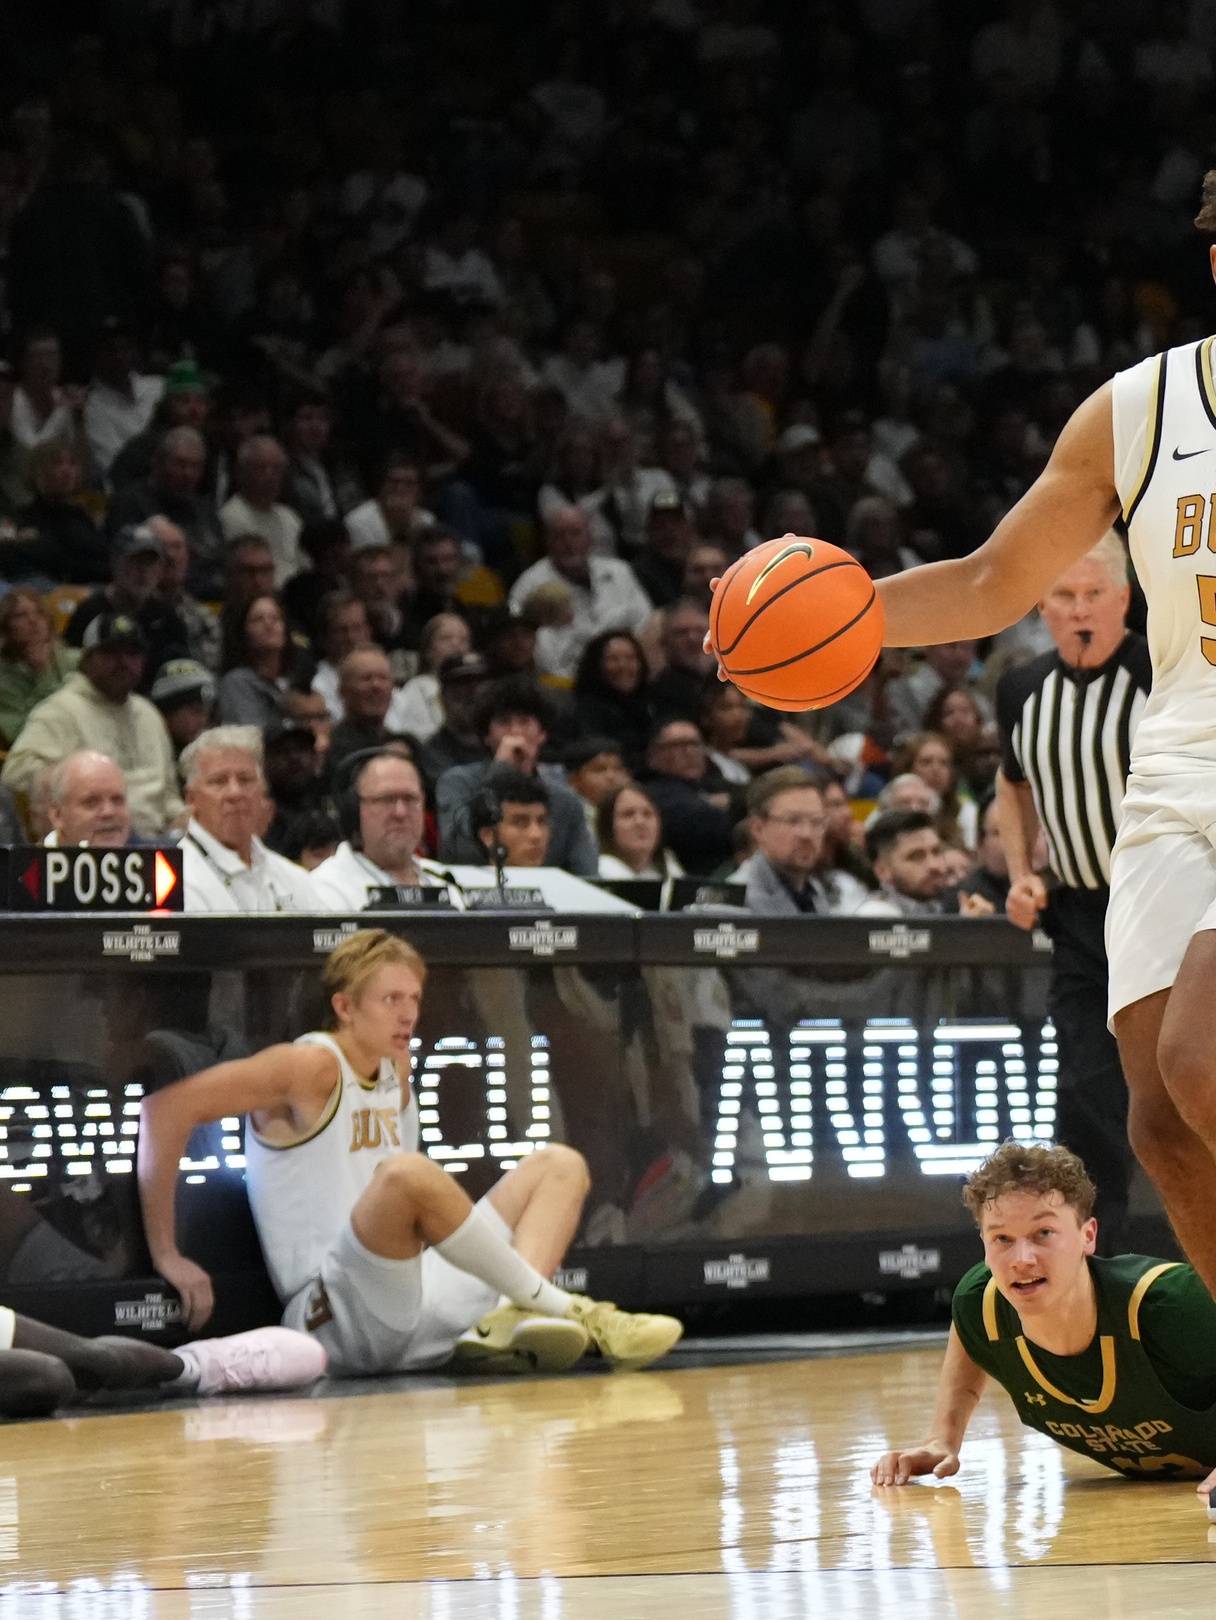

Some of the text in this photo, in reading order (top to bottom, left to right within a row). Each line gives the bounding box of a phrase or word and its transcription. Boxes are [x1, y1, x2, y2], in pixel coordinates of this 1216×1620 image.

[46, 851, 152, 905] POSS.
[103, 935, 179, 949] WILHITE LAW
[313, 933, 348, 947] WILH
[509, 930, 578, 944] WILHITE LAW
[115, 1305, 165, 1319] WILHITE
[1086, 1438, 1162, 1454] STTE
